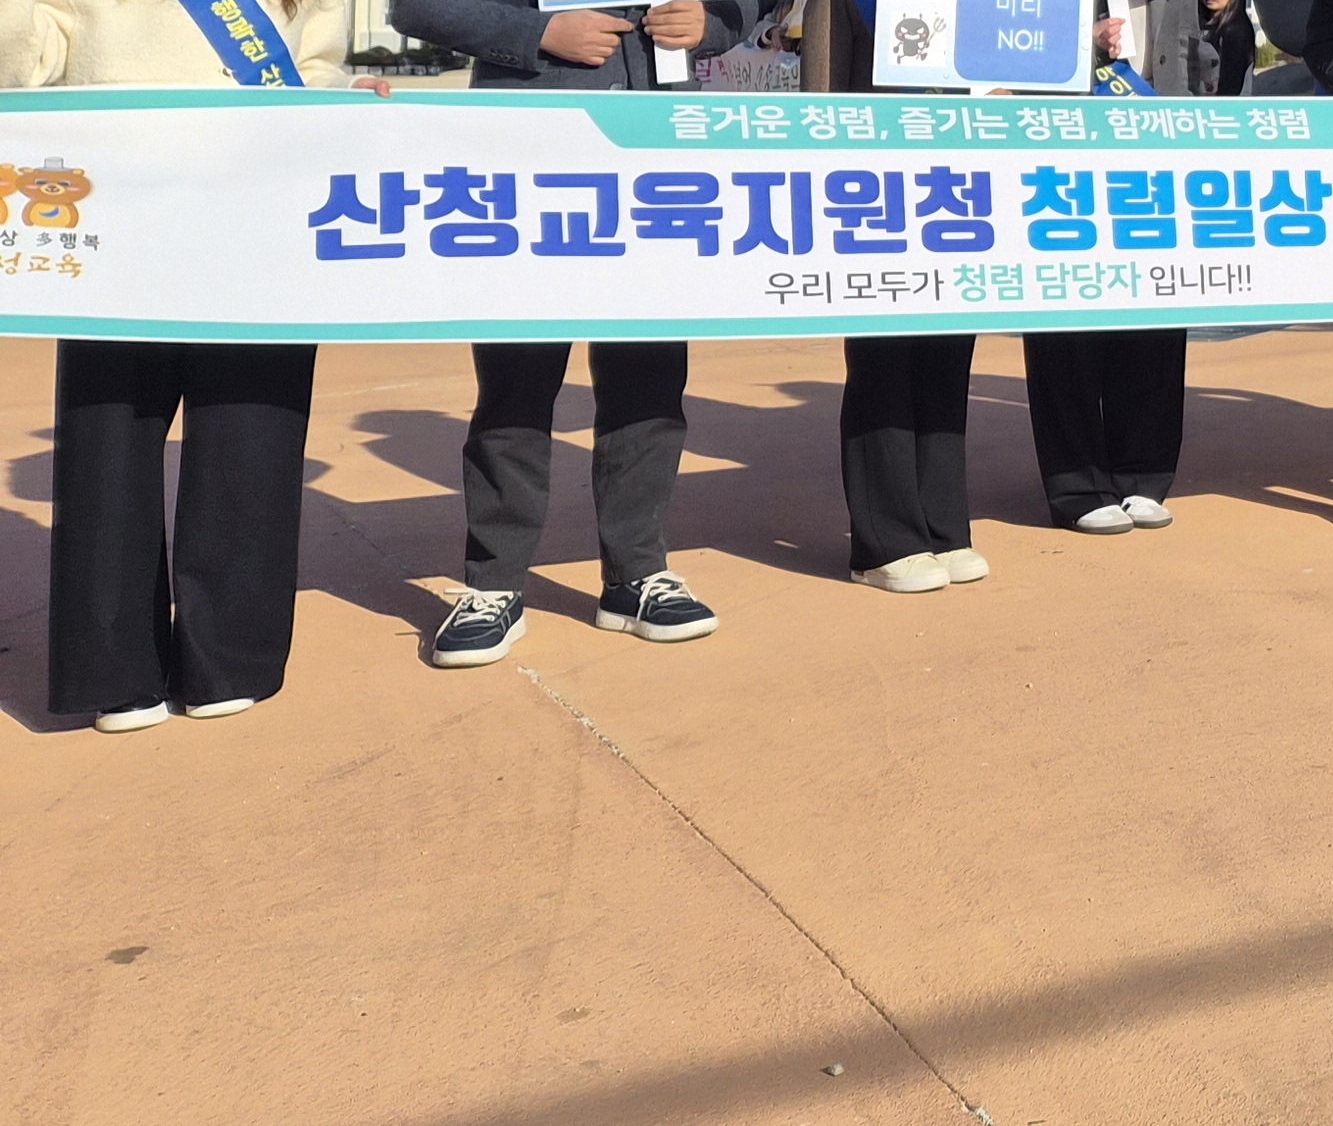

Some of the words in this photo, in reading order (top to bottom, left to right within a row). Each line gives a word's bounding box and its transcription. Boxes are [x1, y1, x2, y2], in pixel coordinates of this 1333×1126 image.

[997, 29, 1045, 51] NO!!
[669, 104, 790, 140] 즐거운
[800, 105, 888, 140] 청렴,
[898, 106, 1009, 140] 즐기는
[1016, 107, 1098, 141] 청렴,
[1105, 108, 1240, 140] 함께하는
[1246, 108, 1310, 140] 청렴
[308, 165, 995, 261] 산청교육지원청
[1020, 166, 1333, 251] 청렴일상
[764, 270, 832, 304] 우리
[843, 269, 945, 302] 모두가
[952, 263, 1024, 302] 청렴
[1035, 261, 1141, 300] 담당자
[1150, 264, 1252, 296] 입니다!!
